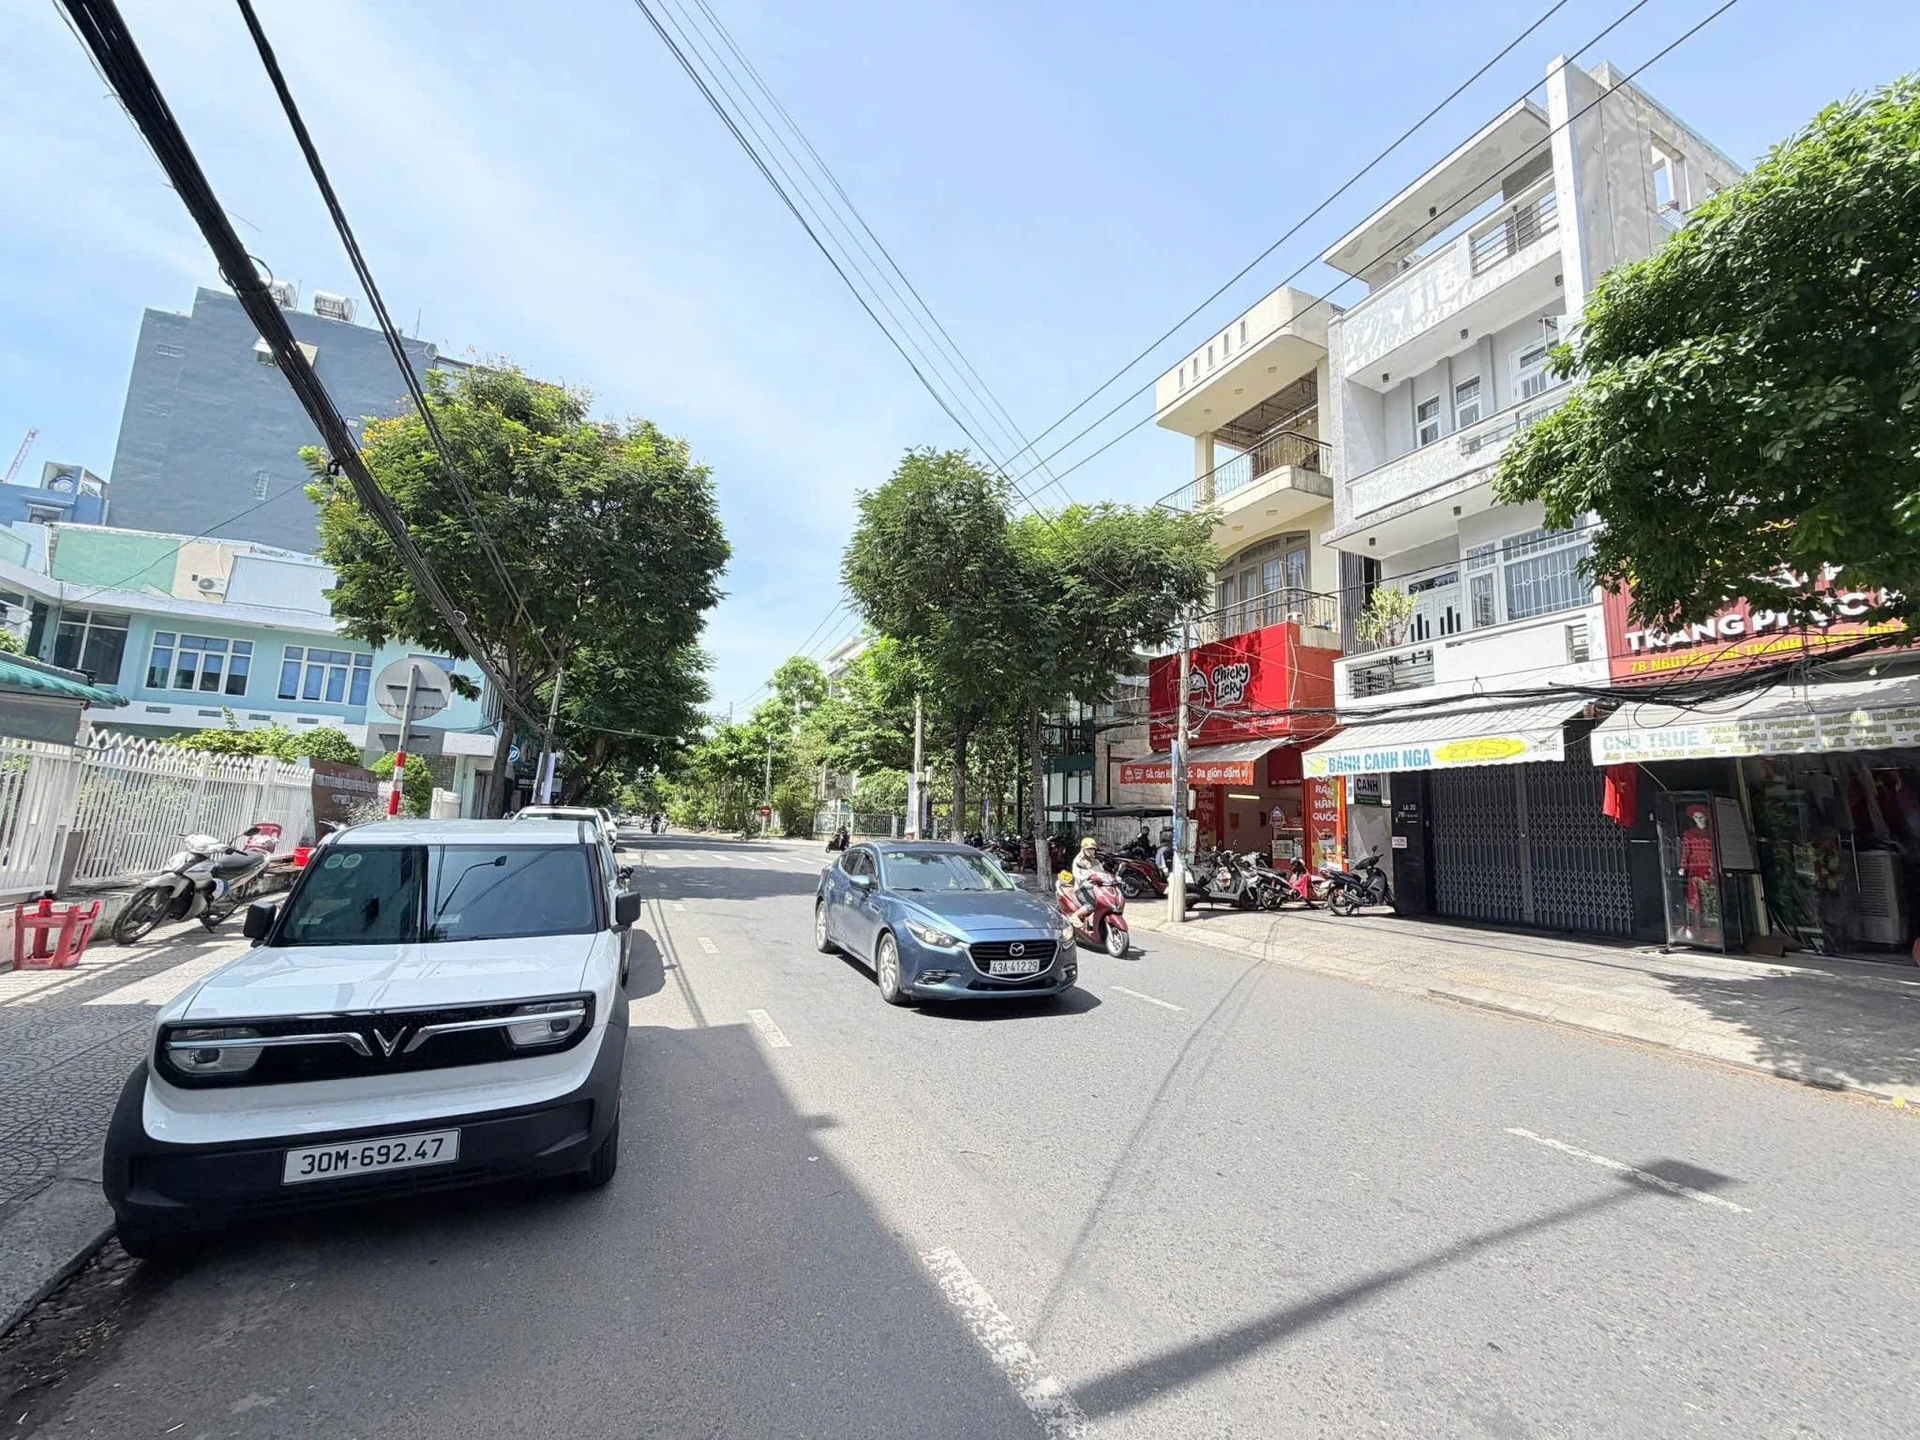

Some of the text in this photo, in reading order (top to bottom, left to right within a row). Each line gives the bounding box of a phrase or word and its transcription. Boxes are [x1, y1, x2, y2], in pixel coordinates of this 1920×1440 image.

[1625, 614, 1745, 651] TRANG
[1213, 664, 1249, 684] Chicky
[1631, 661, 1646, 674] 78
[1216, 679, 1243, 700] Licky
[1648, 726, 1700, 748] THUÊ
[1328, 748, 1432, 773] BÁNH CANH NGA
[1315, 784, 1335, 795] RÁN
[1356, 778, 1379, 792] CANH
[1314, 798, 1336, 809] HÀN
[1312, 811, 1338, 822] QUỐC
[300, 1137, 444, 1175] 30M-692.47
